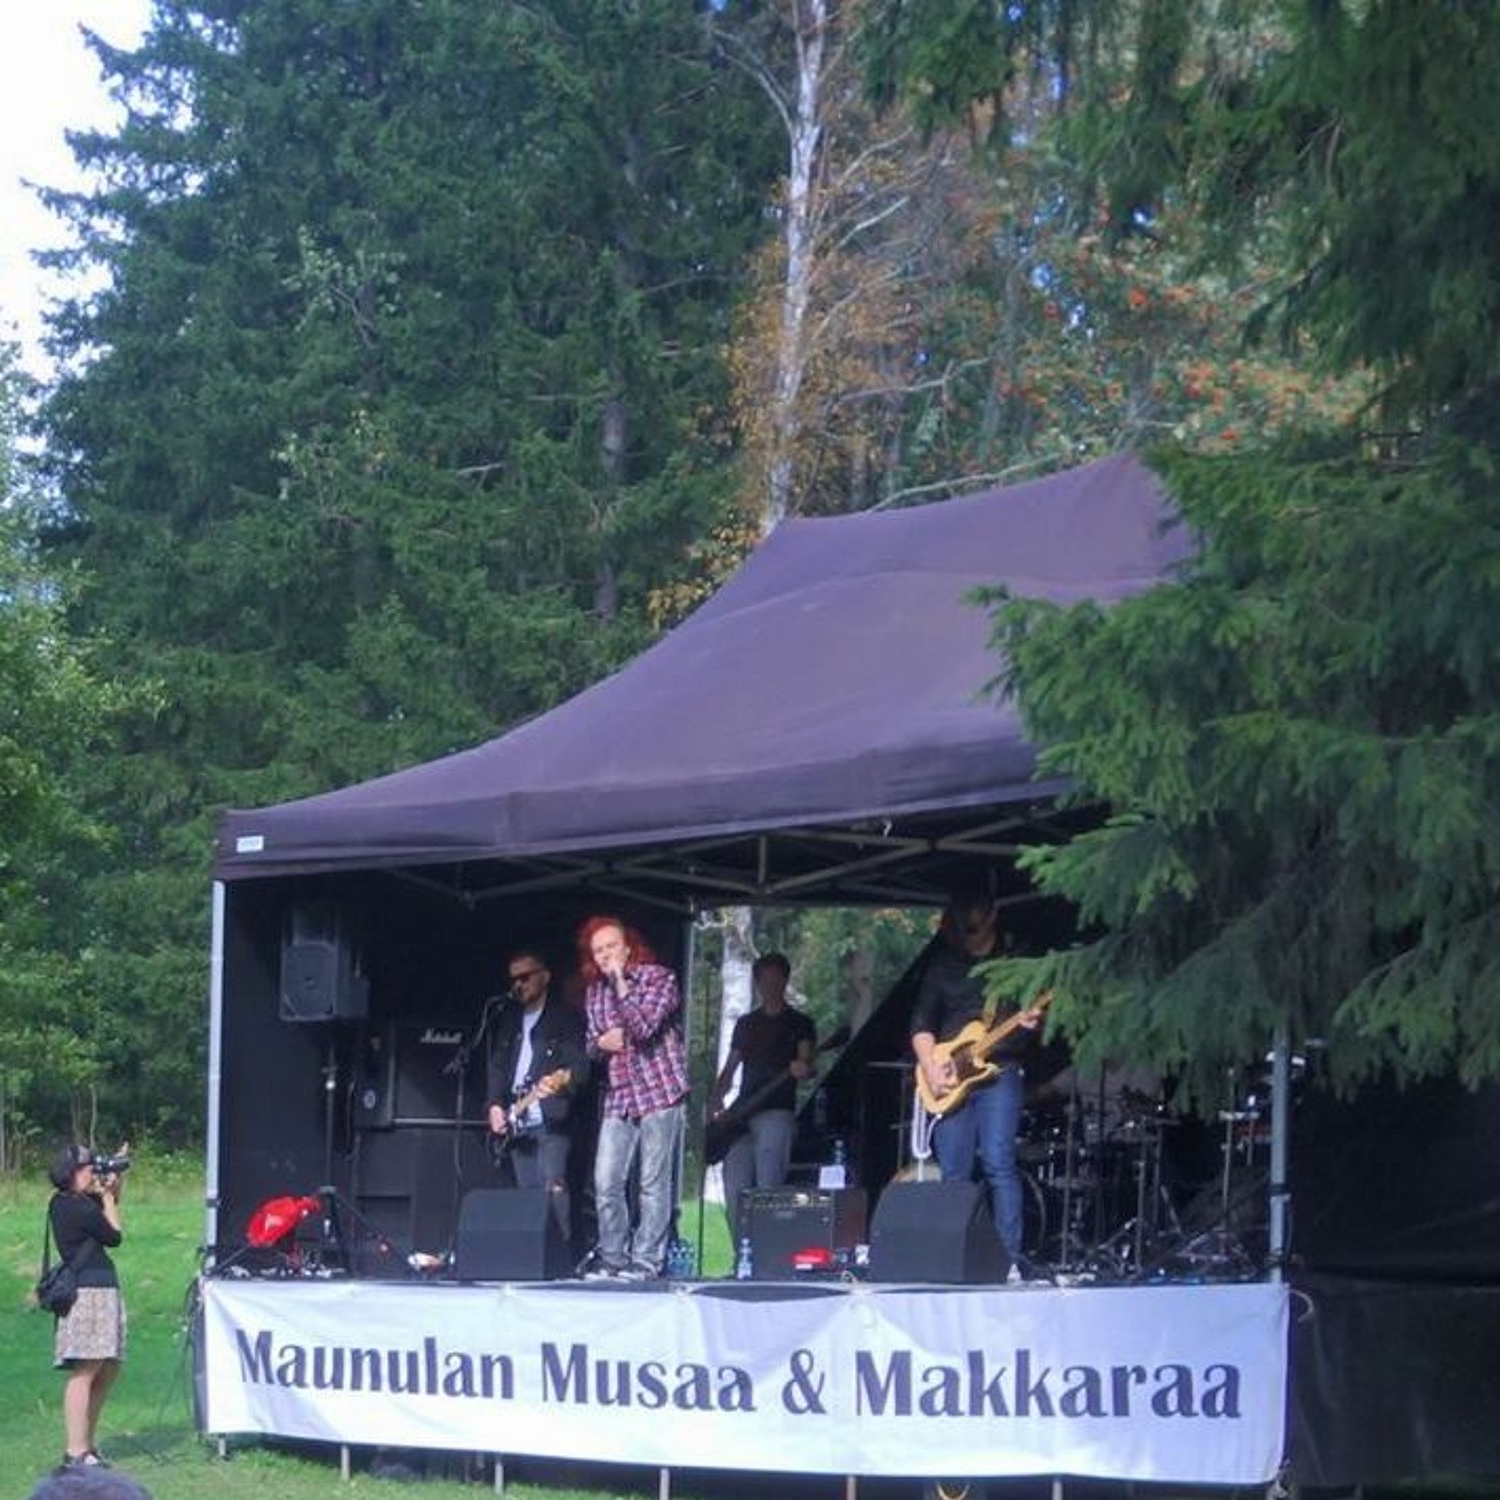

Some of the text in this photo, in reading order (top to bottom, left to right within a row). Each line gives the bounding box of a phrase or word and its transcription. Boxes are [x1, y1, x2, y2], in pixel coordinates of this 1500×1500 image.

[235, 1328, 1242, 1418] Maunulan Musaa & Makkaraa
